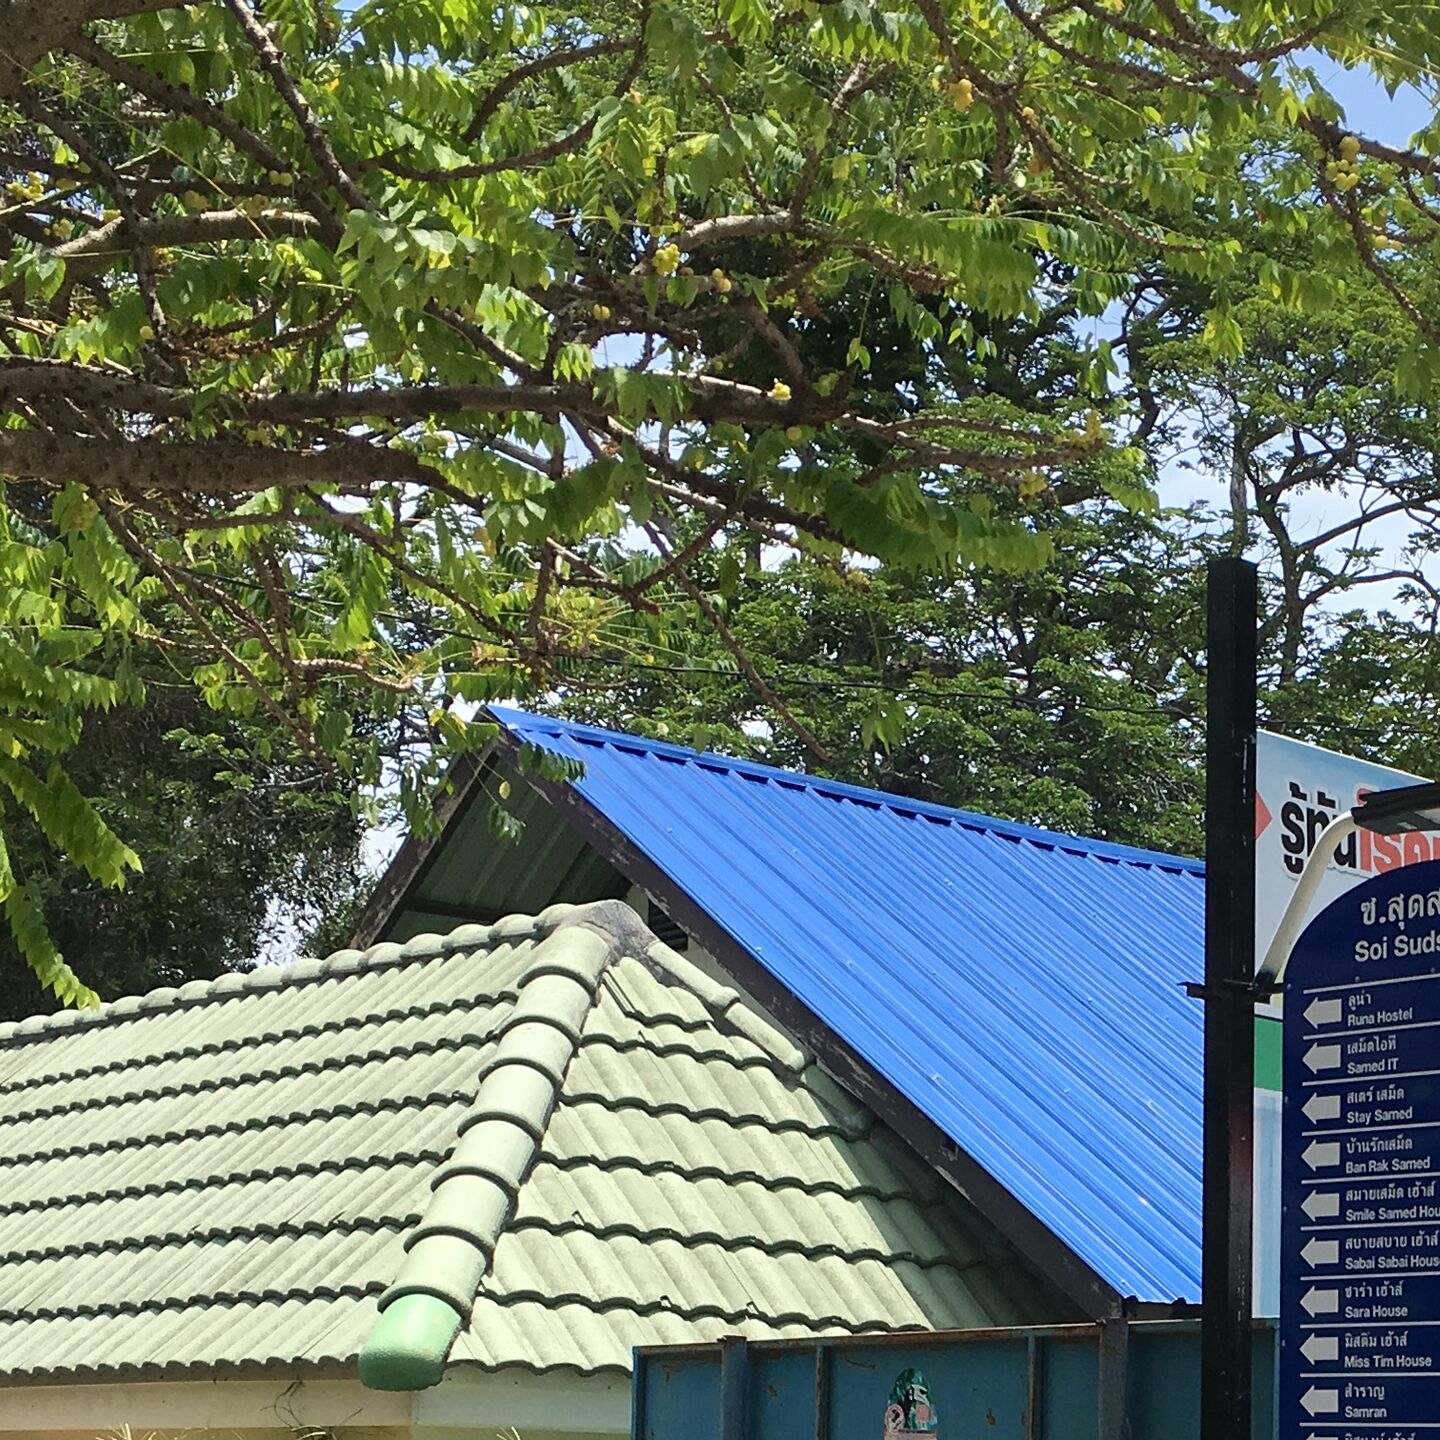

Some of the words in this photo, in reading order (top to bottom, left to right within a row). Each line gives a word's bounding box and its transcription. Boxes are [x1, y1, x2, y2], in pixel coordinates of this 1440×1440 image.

[1355, 939, 1387, 962] Soi
[1347, 1014, 1375, 1026] Runa
[1377, 1008, 1412, 1023] Hostel
[1347, 1060, 1385, 1074] Samed
[1388, 1058, 1399, 1070] IT
[1347, 1111, 1371, 1125] Stay
[1375, 1107, 1413, 1121] Samed
[1346, 1162, 1366, 1174] Ban
[1369, 1160, 1389, 1172] Rak
[1392, 1157, 1430, 1170] Samed
[1346, 1208, 1375, 1221] Smile
[1379, 1207, 1417, 1220] Samed
[1345, 1258, 1375, 1270] Sabai
[1378, 1257, 1408, 1269] Sabai
[1345, 1306, 1369, 1318] Sara
[1373, 1305, 1408, 1318] House
[1345, 1356, 1370, 1368] Miss
[1373, 1355, 1393, 1367] Tim
[1396, 1355, 1432, 1367] House
[1345, 1383, 1385, 1401] สำราญ
[1345, 1406, 1387, 1418] Samran
